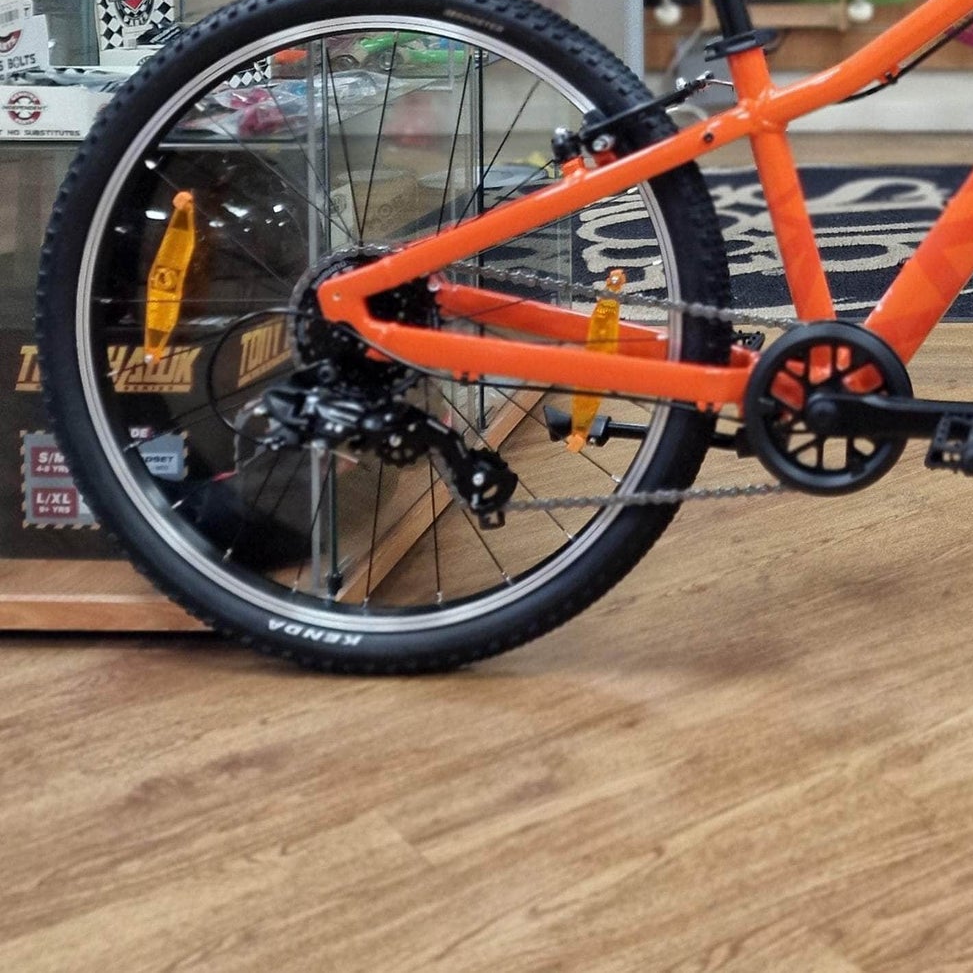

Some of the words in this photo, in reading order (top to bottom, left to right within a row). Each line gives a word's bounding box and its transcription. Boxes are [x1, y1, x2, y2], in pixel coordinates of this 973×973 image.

[7, 53, 36, 70] BOLTS
[36, 493, 71, 505] L/XL
[268, 618, 363, 646] KENDA
